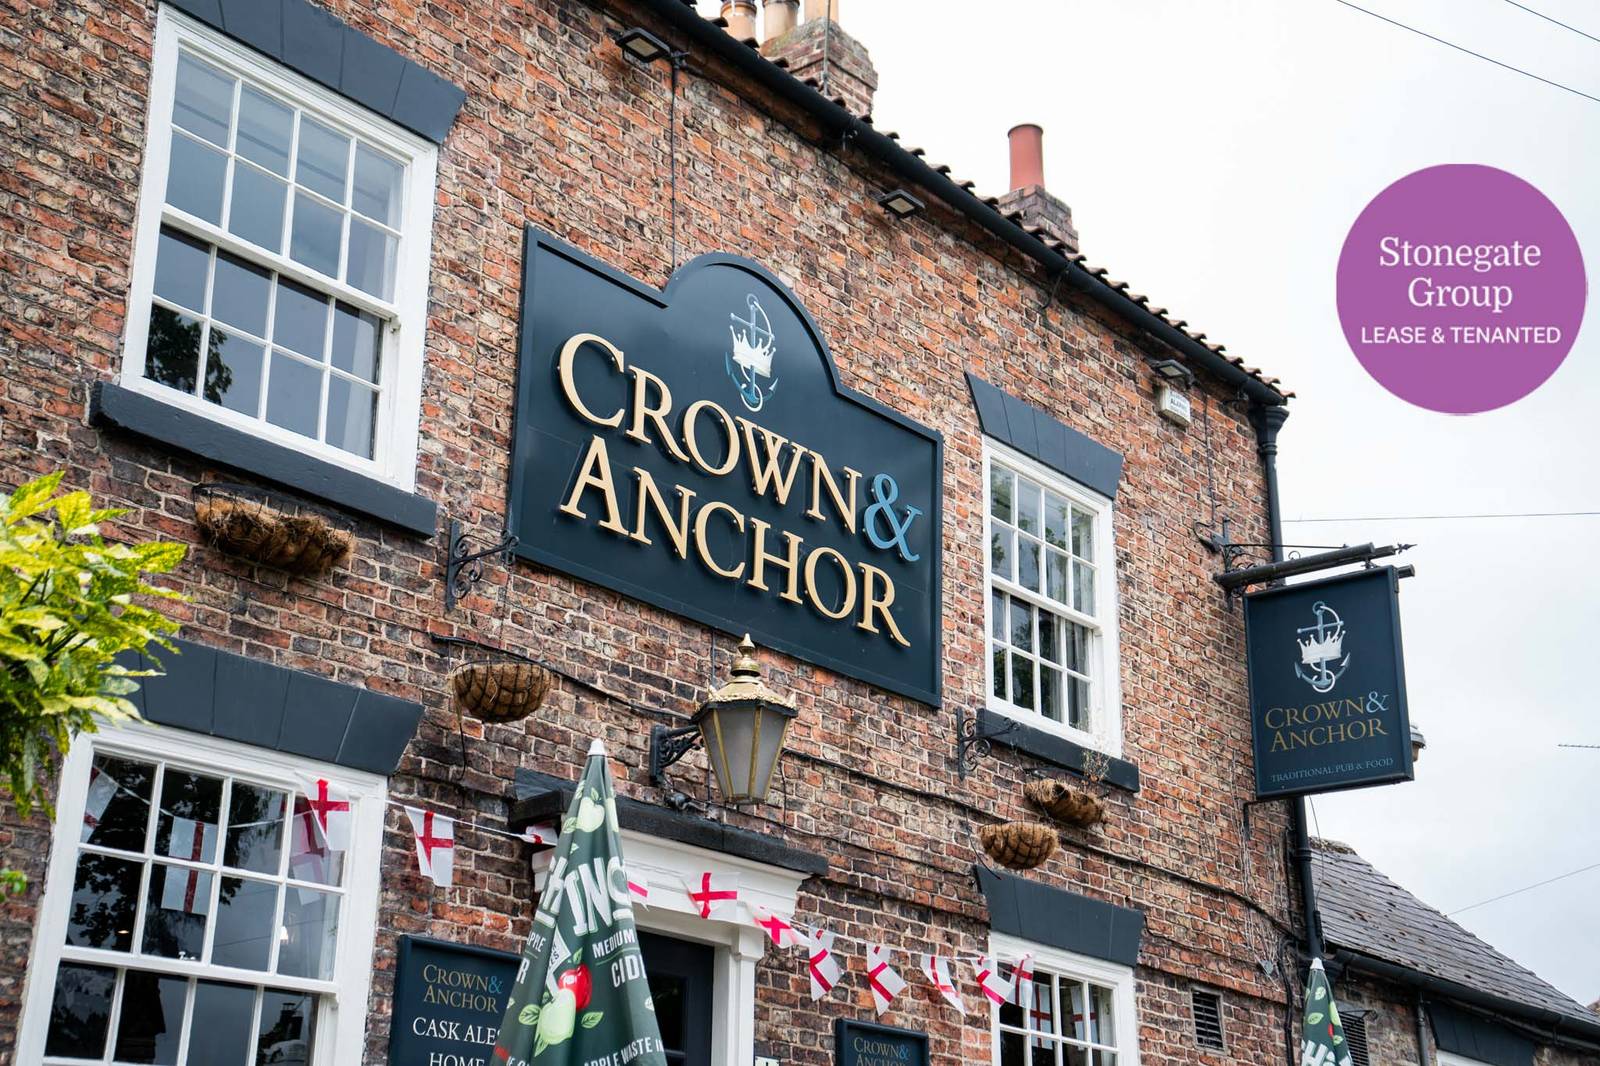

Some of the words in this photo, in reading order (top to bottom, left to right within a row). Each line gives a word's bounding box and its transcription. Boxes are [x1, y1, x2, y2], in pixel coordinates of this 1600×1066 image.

[560, 435, 911, 648] ANCHOR
[1270, 718, 1389, 752] ANCHOR
[1271, 765, 1334, 782] TRADITIONAL
[1335, 762, 1354, 773] PUB
[1365, 757, 1394, 769] FOOD
[592, 928, 635, 958] MEDIUM
[424, 985, 498, 1013] ANCHOR
[412, 1017, 460, 1041] CASK
[621, 1037, 653, 1064] WASTE
